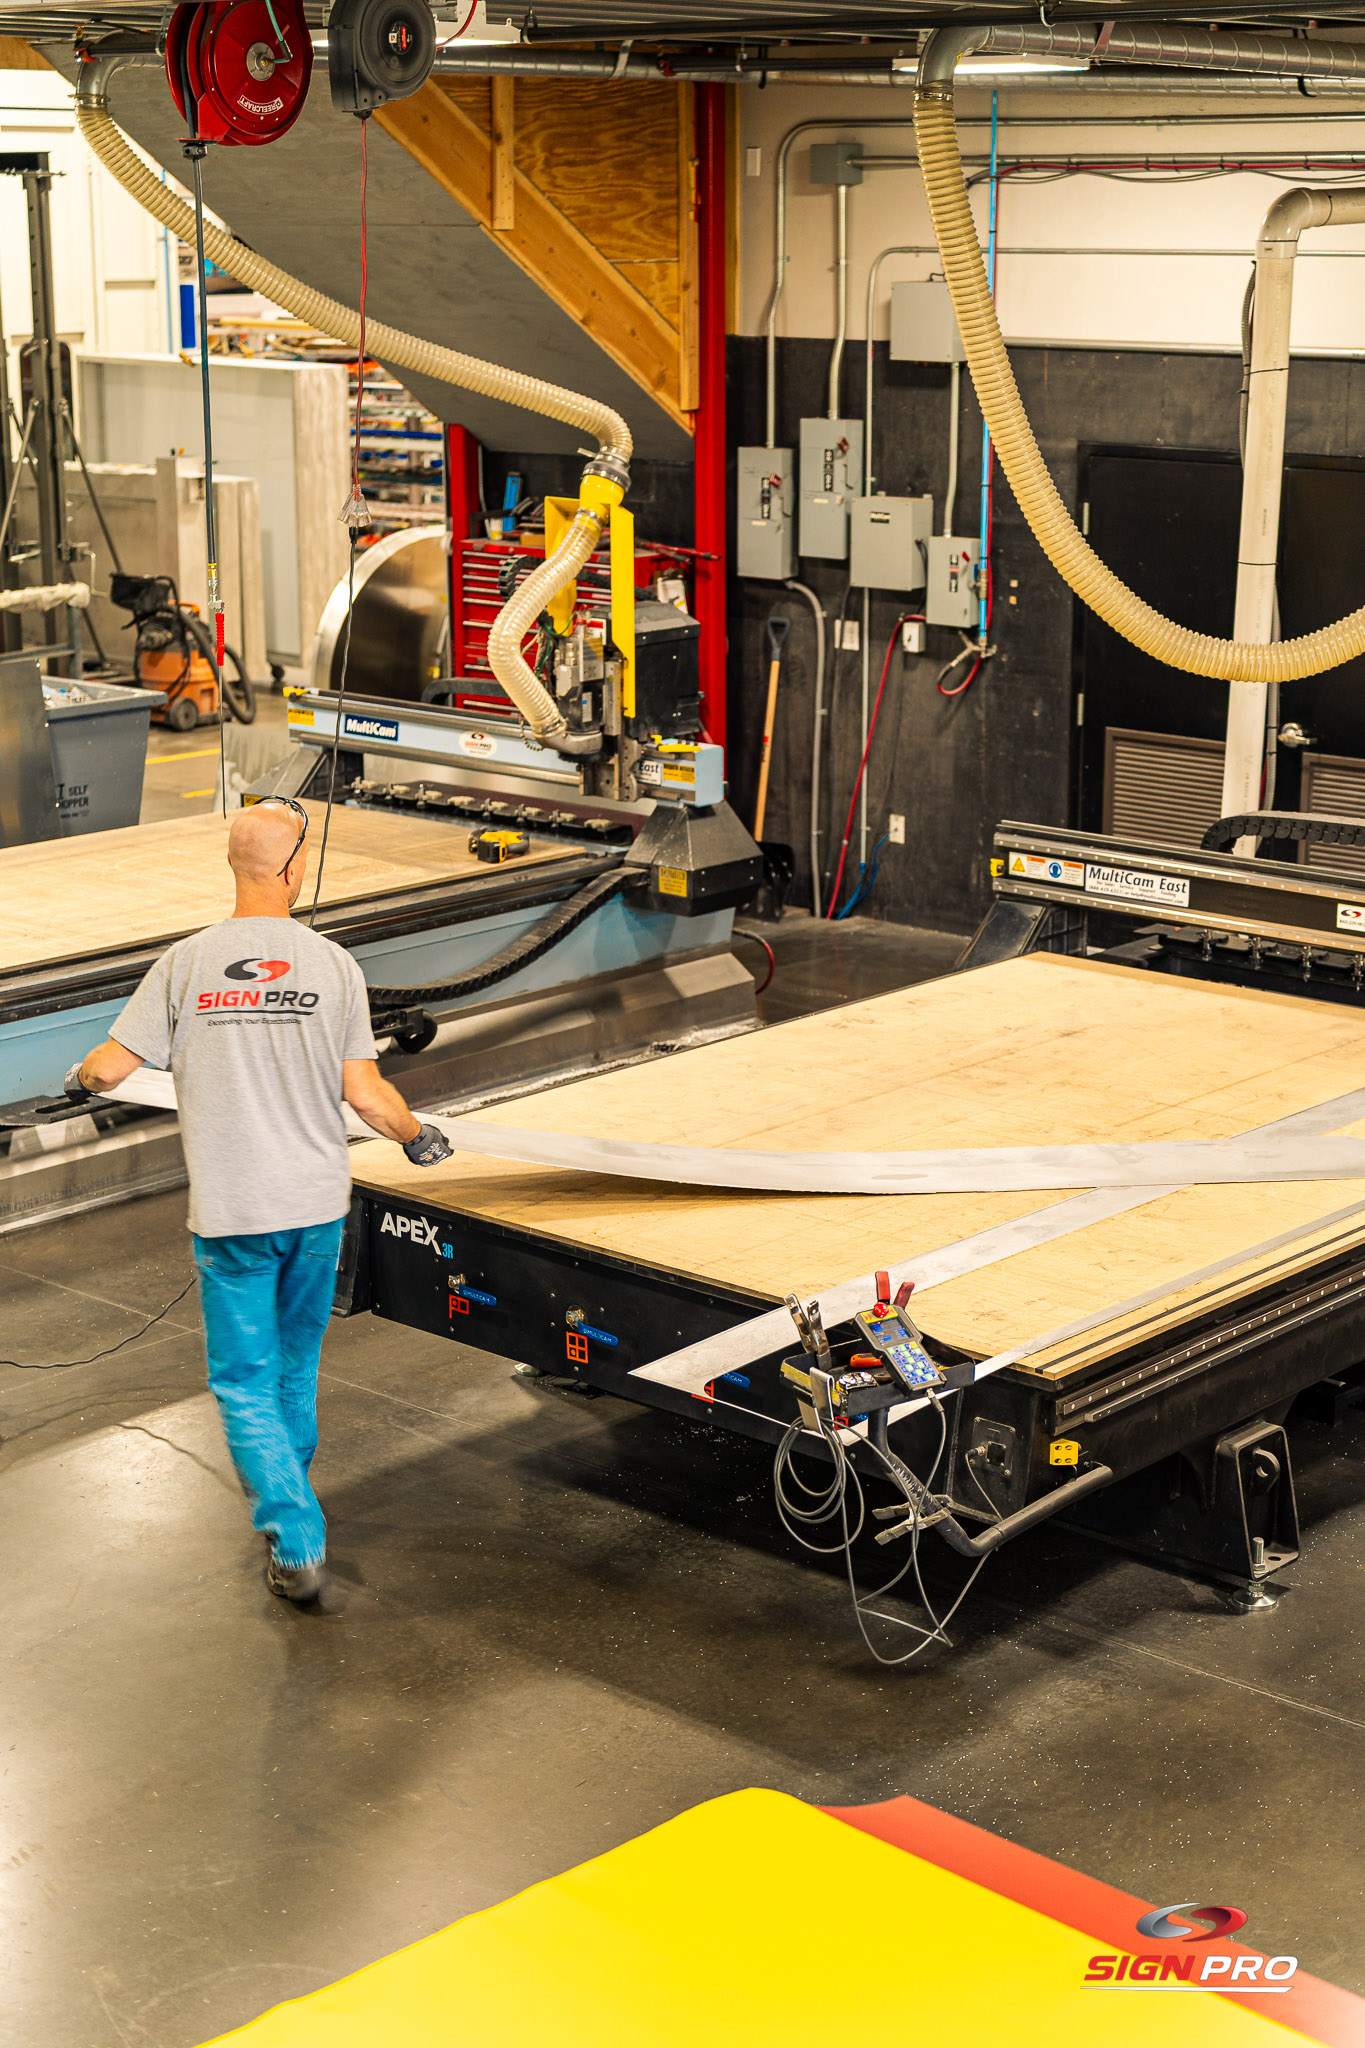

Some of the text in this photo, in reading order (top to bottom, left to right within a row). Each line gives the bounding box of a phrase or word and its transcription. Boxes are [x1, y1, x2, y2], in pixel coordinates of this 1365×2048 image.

[240, 97, 277, 112] REELCRAFT
[346, 718, 397, 738] MultiCam
[1089, 867, 1154, 888] MultiCam
[1160, 878, 1188, 893] East
[197, 990, 319, 1010] SIGN PRO
[380, 1212, 454, 1259] APEX 3R
